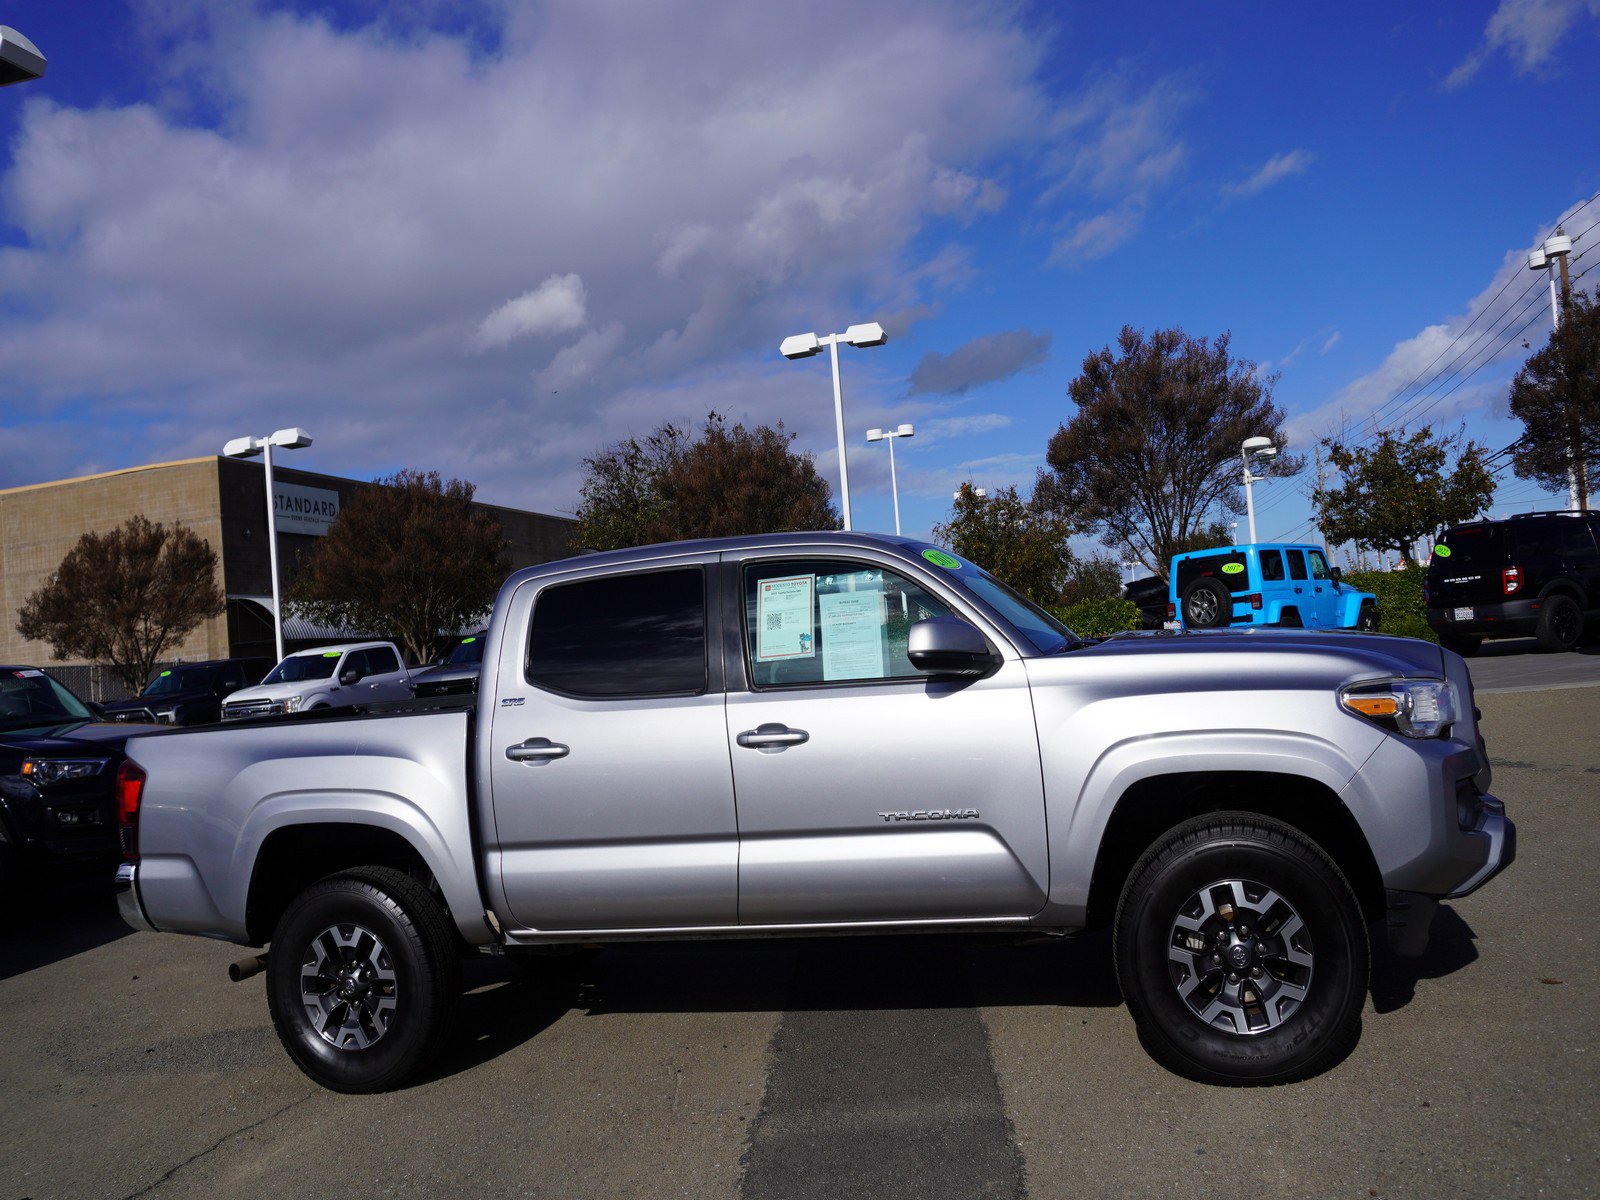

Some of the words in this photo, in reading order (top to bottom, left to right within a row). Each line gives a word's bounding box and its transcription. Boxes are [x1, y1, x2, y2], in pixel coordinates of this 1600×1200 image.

[1225, 564, 1241, 572] 2017
[1443, 575, 1481, 583] BRONCO
[878, 808, 980, 821] TACOMA
